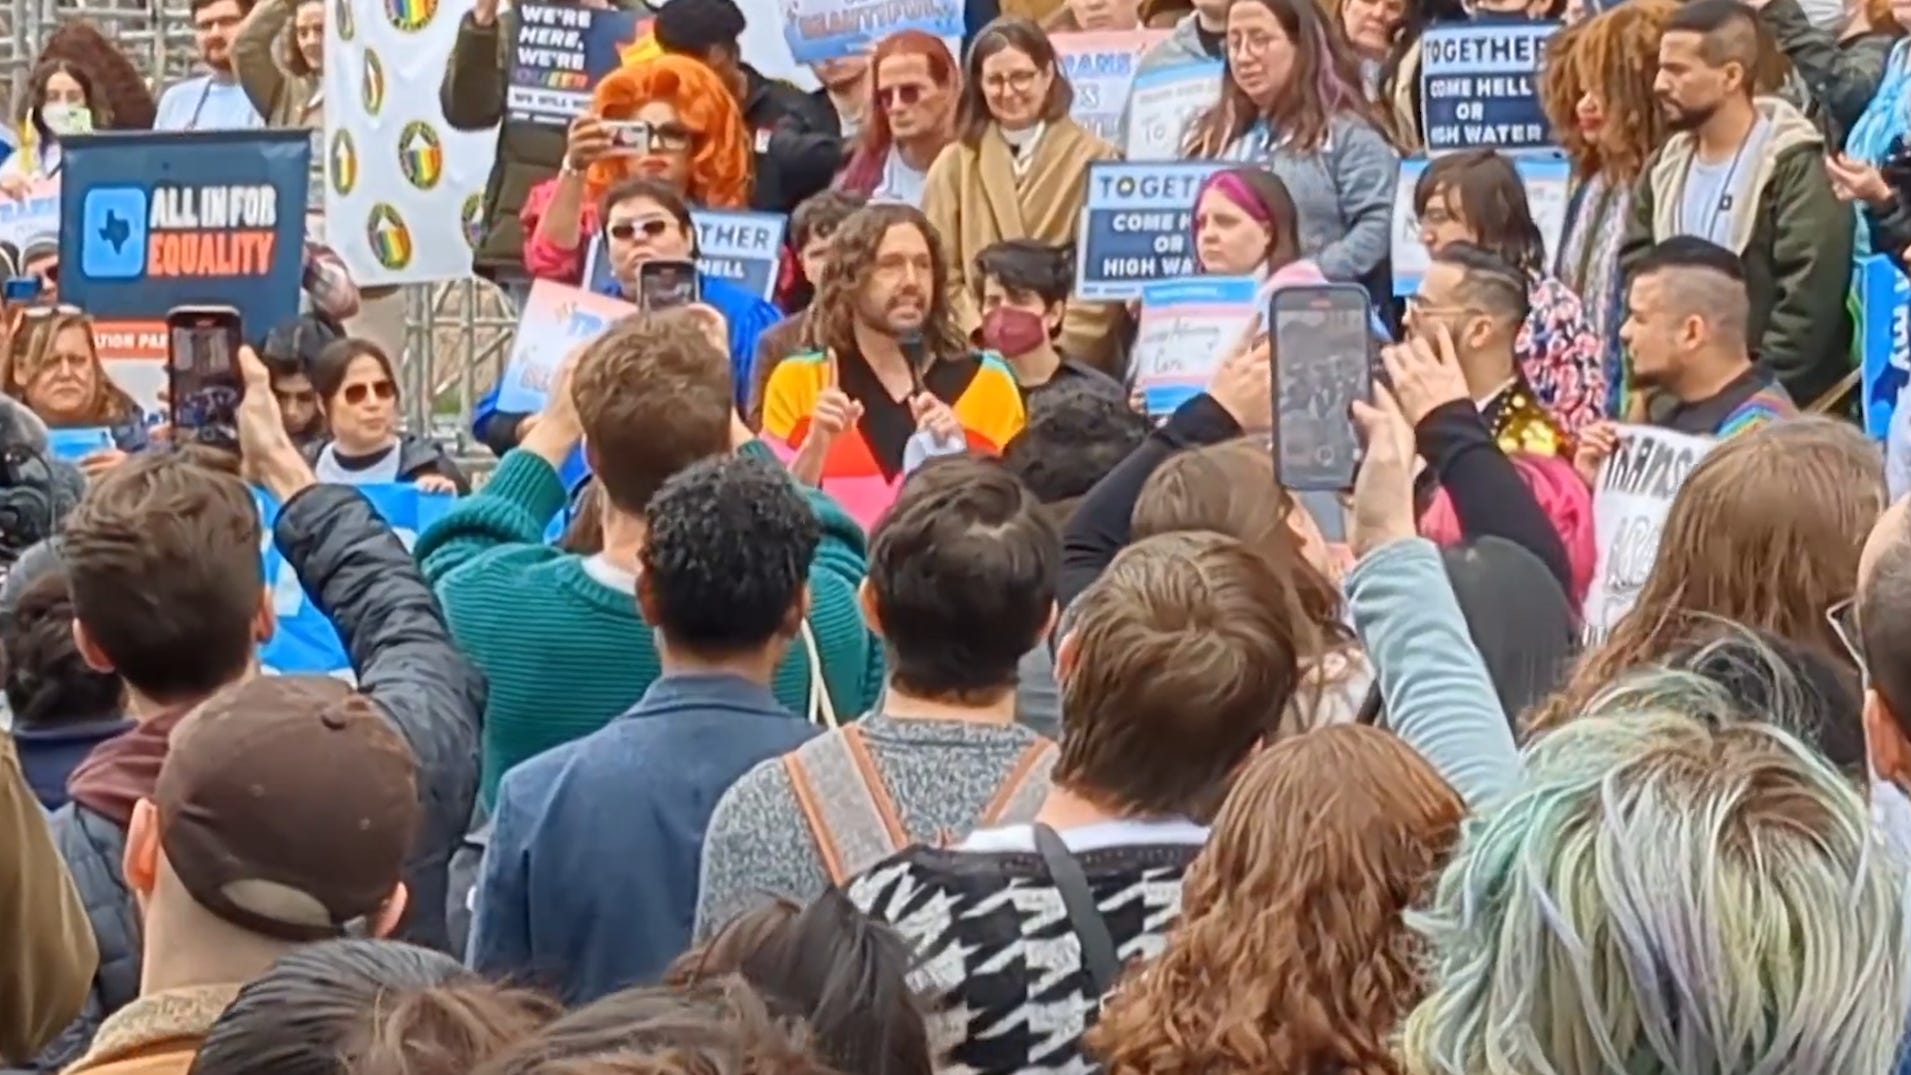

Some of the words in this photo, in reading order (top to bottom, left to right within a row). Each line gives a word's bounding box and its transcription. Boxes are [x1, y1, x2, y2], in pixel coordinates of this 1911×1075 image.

[521, 4, 592, 28] WE'RE
[518, 46, 585, 70] WE'RE
[1430, 79, 1472, 98] COME
[1477, 78, 1532, 97] HELL
[1456, 102, 1483, 121] OR
[1463, 123, 1541, 143] WATER
[1097, 174, 1206, 199] TOGET
[149, 187, 198, 229] ALL
[201, 186, 226, 228] IN
[229, 185, 277, 228] FOR
[1112, 213, 1174, 232] COME
[699, 223, 770, 250] THER
[1153, 235, 1184, 253] OR
[147, 231, 275, 276] EQUALITY
[1103, 257, 1155, 276] HIGH
